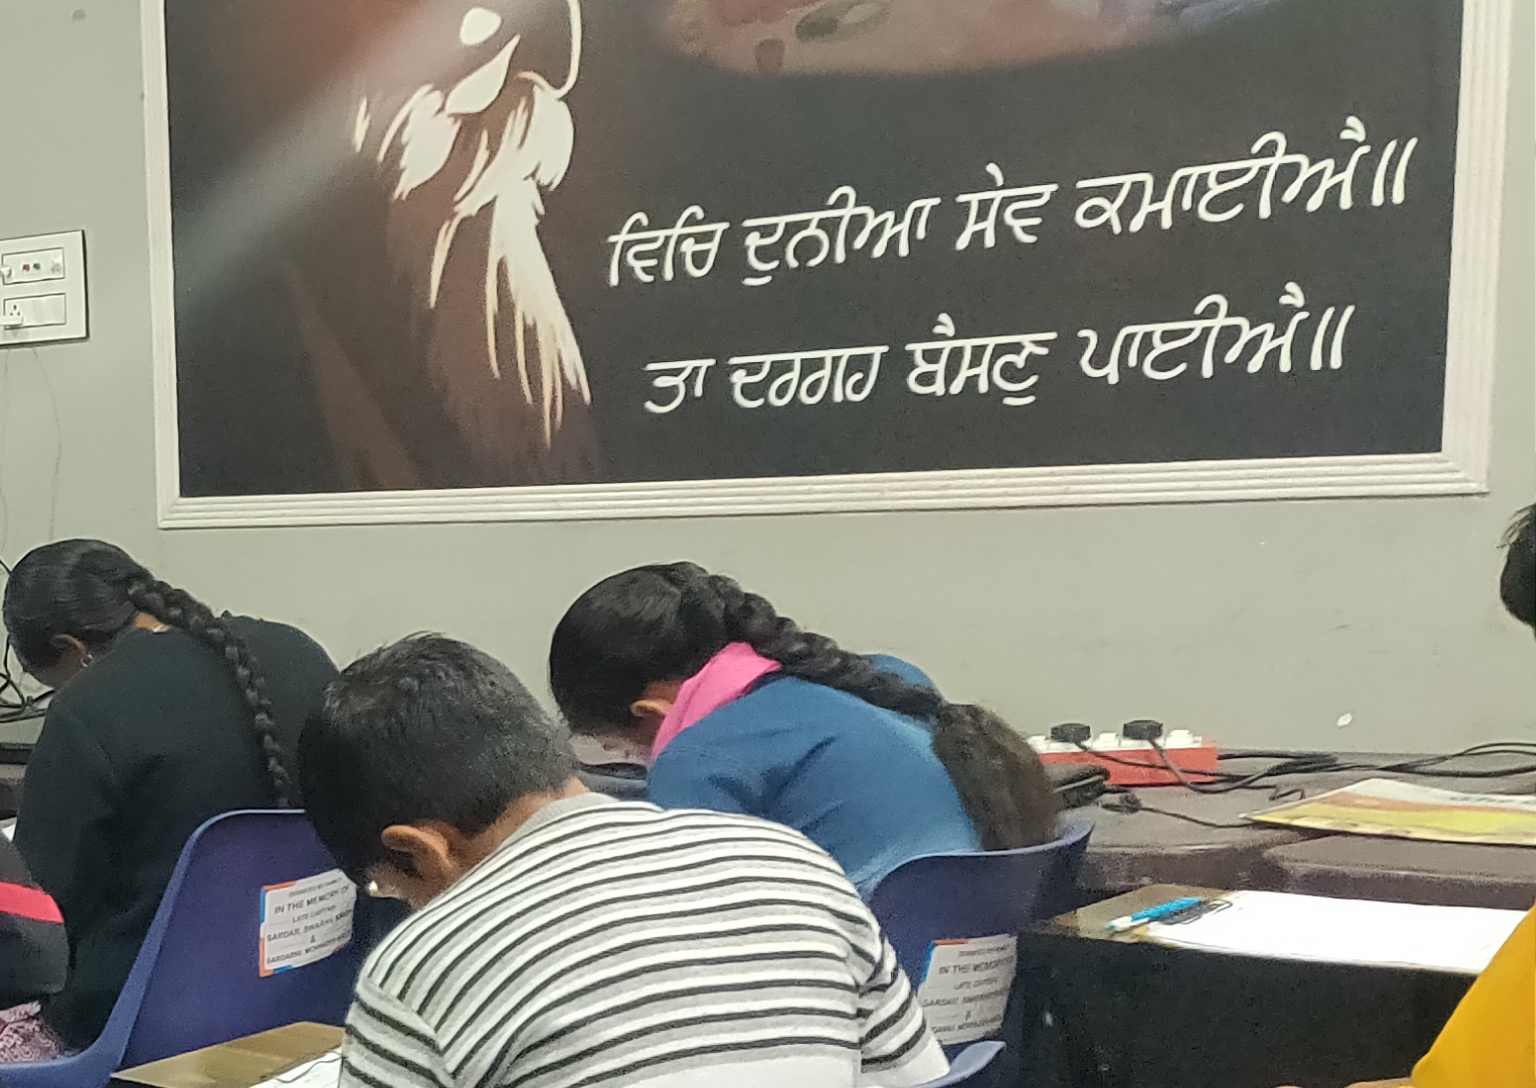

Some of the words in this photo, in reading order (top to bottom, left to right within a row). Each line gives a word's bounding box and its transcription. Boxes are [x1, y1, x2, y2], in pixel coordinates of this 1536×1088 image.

[606, 205, 730, 287] ਵਿਚਿ
[742, 185, 941, 285] ਦੁਨੀਆ
[955, 163, 1059, 249] ਸੇਵ
[644, 358, 716, 413] ਤਾ
[727, 345, 890, 408] ਦਰਗਹ
[905, 312, 1059, 406] ਬੈਸਣੁ
[275, 905, 284, 914] IN
[288, 900, 304, 911] THE
